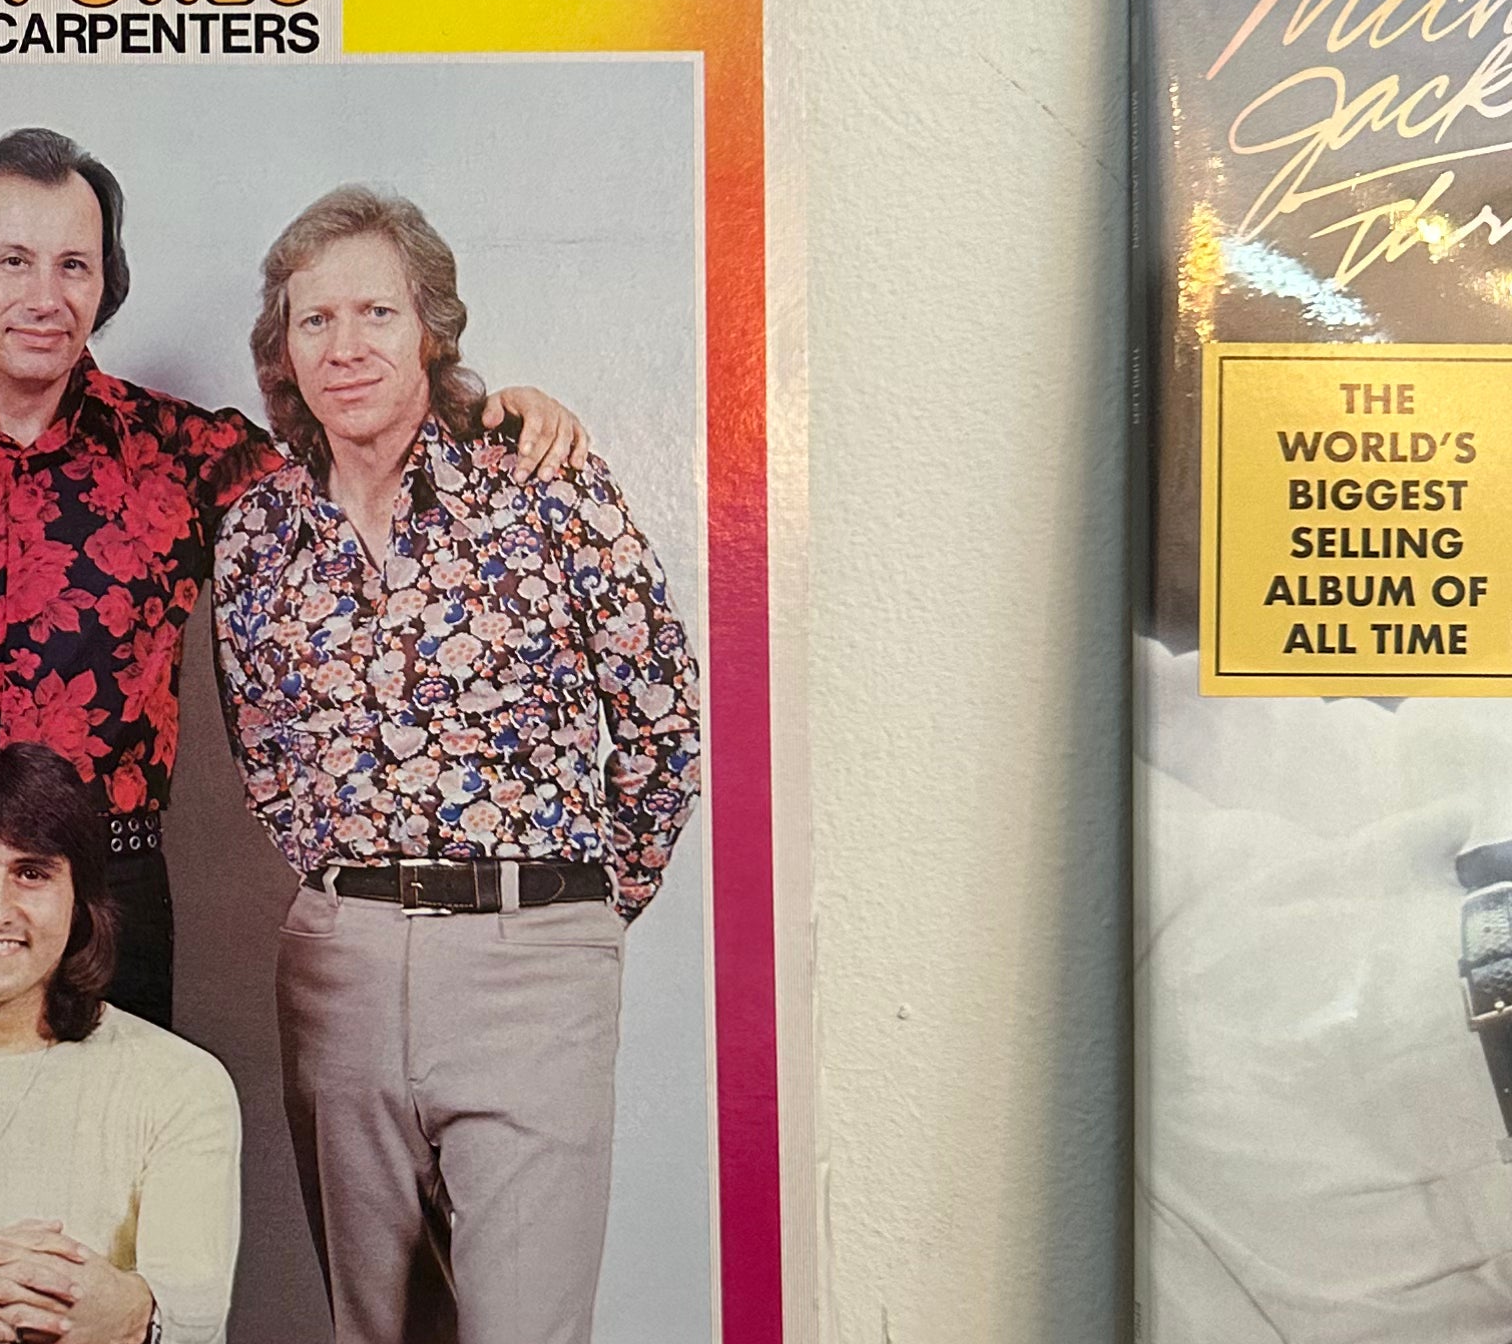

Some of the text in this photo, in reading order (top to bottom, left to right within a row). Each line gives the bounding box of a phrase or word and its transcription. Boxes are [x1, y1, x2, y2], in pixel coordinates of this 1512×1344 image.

[1339, 383, 1415, 415] THE
[1277, 431, 1477, 464] WORLD'S
[1289, 479, 1468, 511] BIGGEST
[1289, 526, 1464, 559] SELLING
[1263, 575, 1488, 607] ALBUM OF
[1282, 623, 1468, 654] ALL TIME
